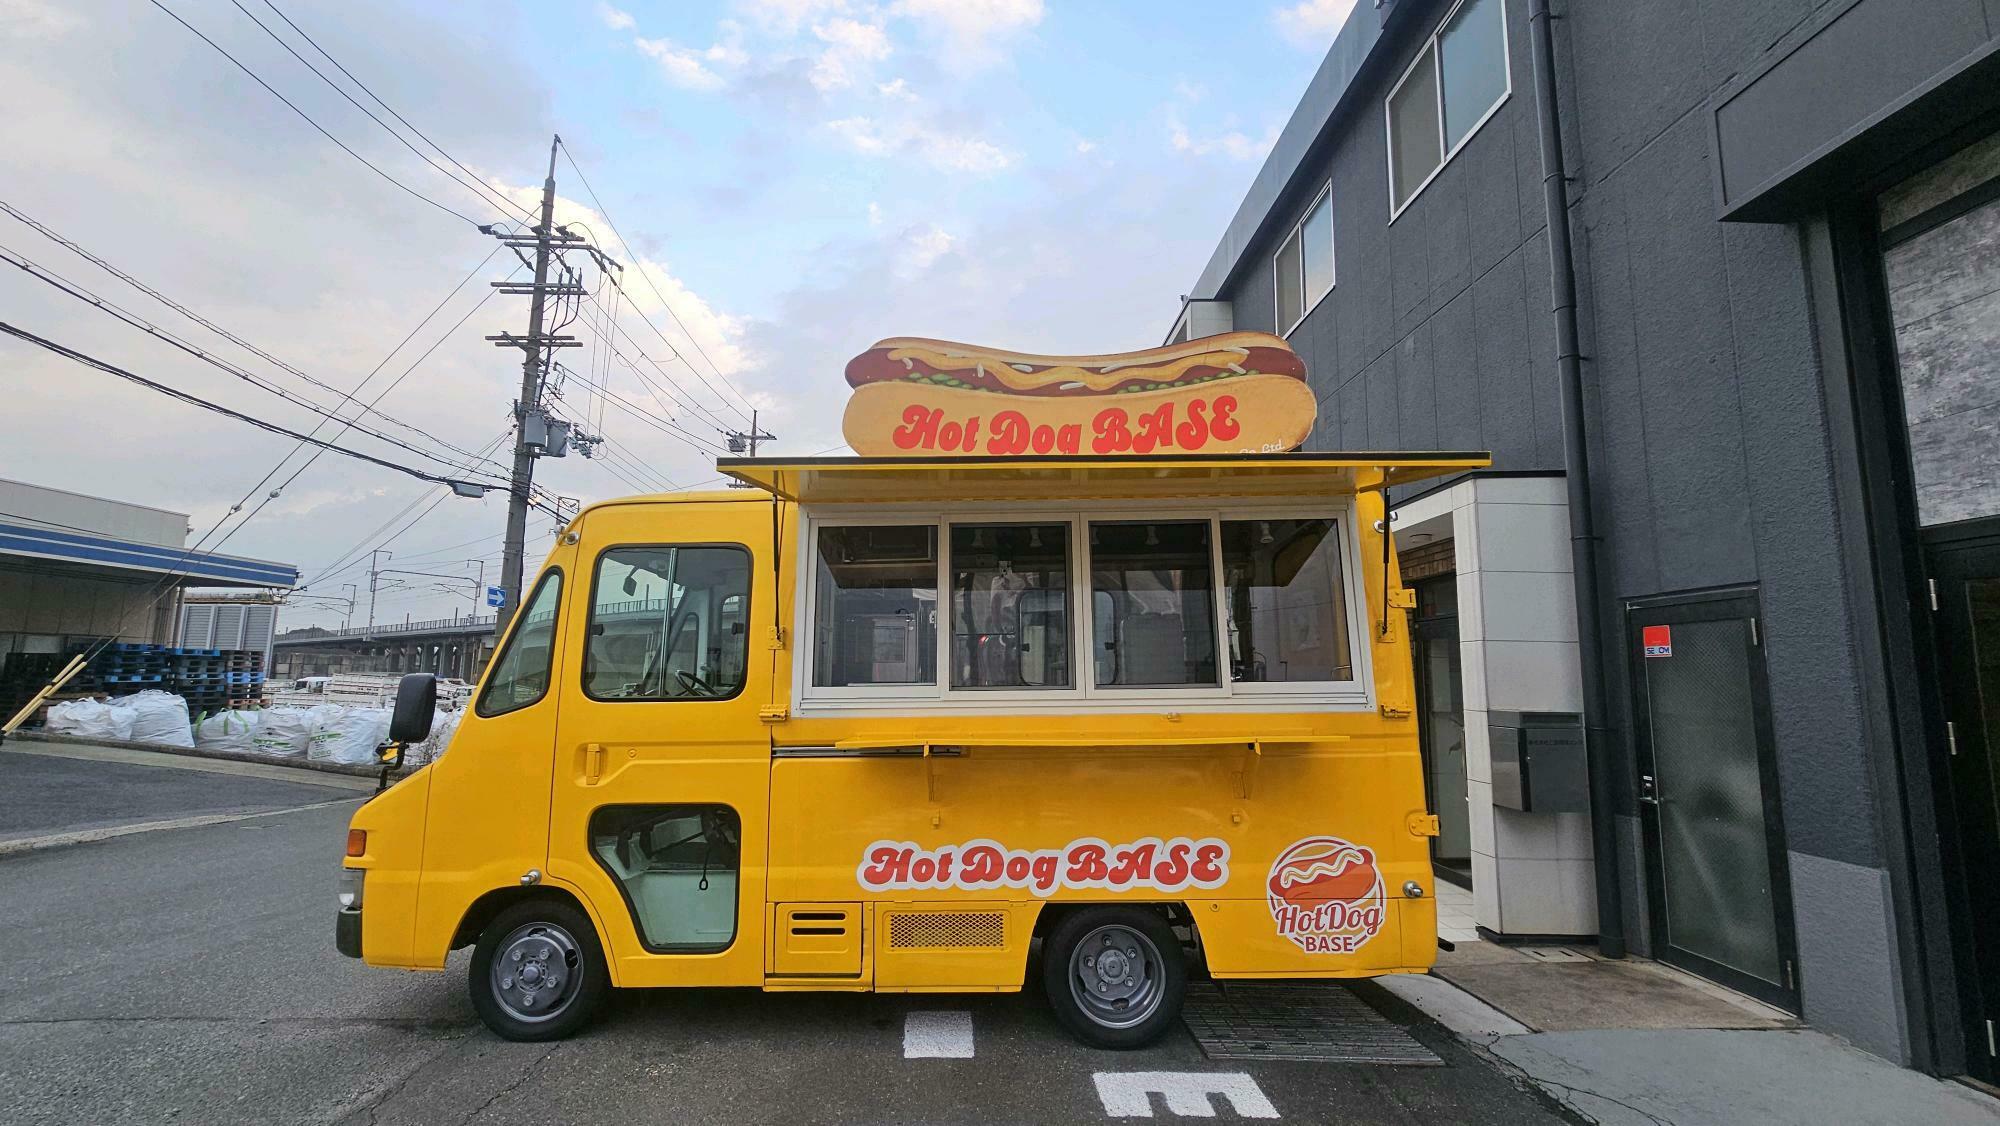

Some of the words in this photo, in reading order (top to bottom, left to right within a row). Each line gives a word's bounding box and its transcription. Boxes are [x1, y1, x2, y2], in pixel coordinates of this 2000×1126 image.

[892, 404, 979, 453] Hot
[986, 410, 1082, 455] Dog
[1091, 395, 1241, 455] BASE
[1646, 647, 1670, 655] SEOM
[863, 847, 953, 885] Hot
[959, 845, 1060, 890] Dog
[1066, 844, 1224, 886] BASE
[1305, 936, 1354, 952] BASE
